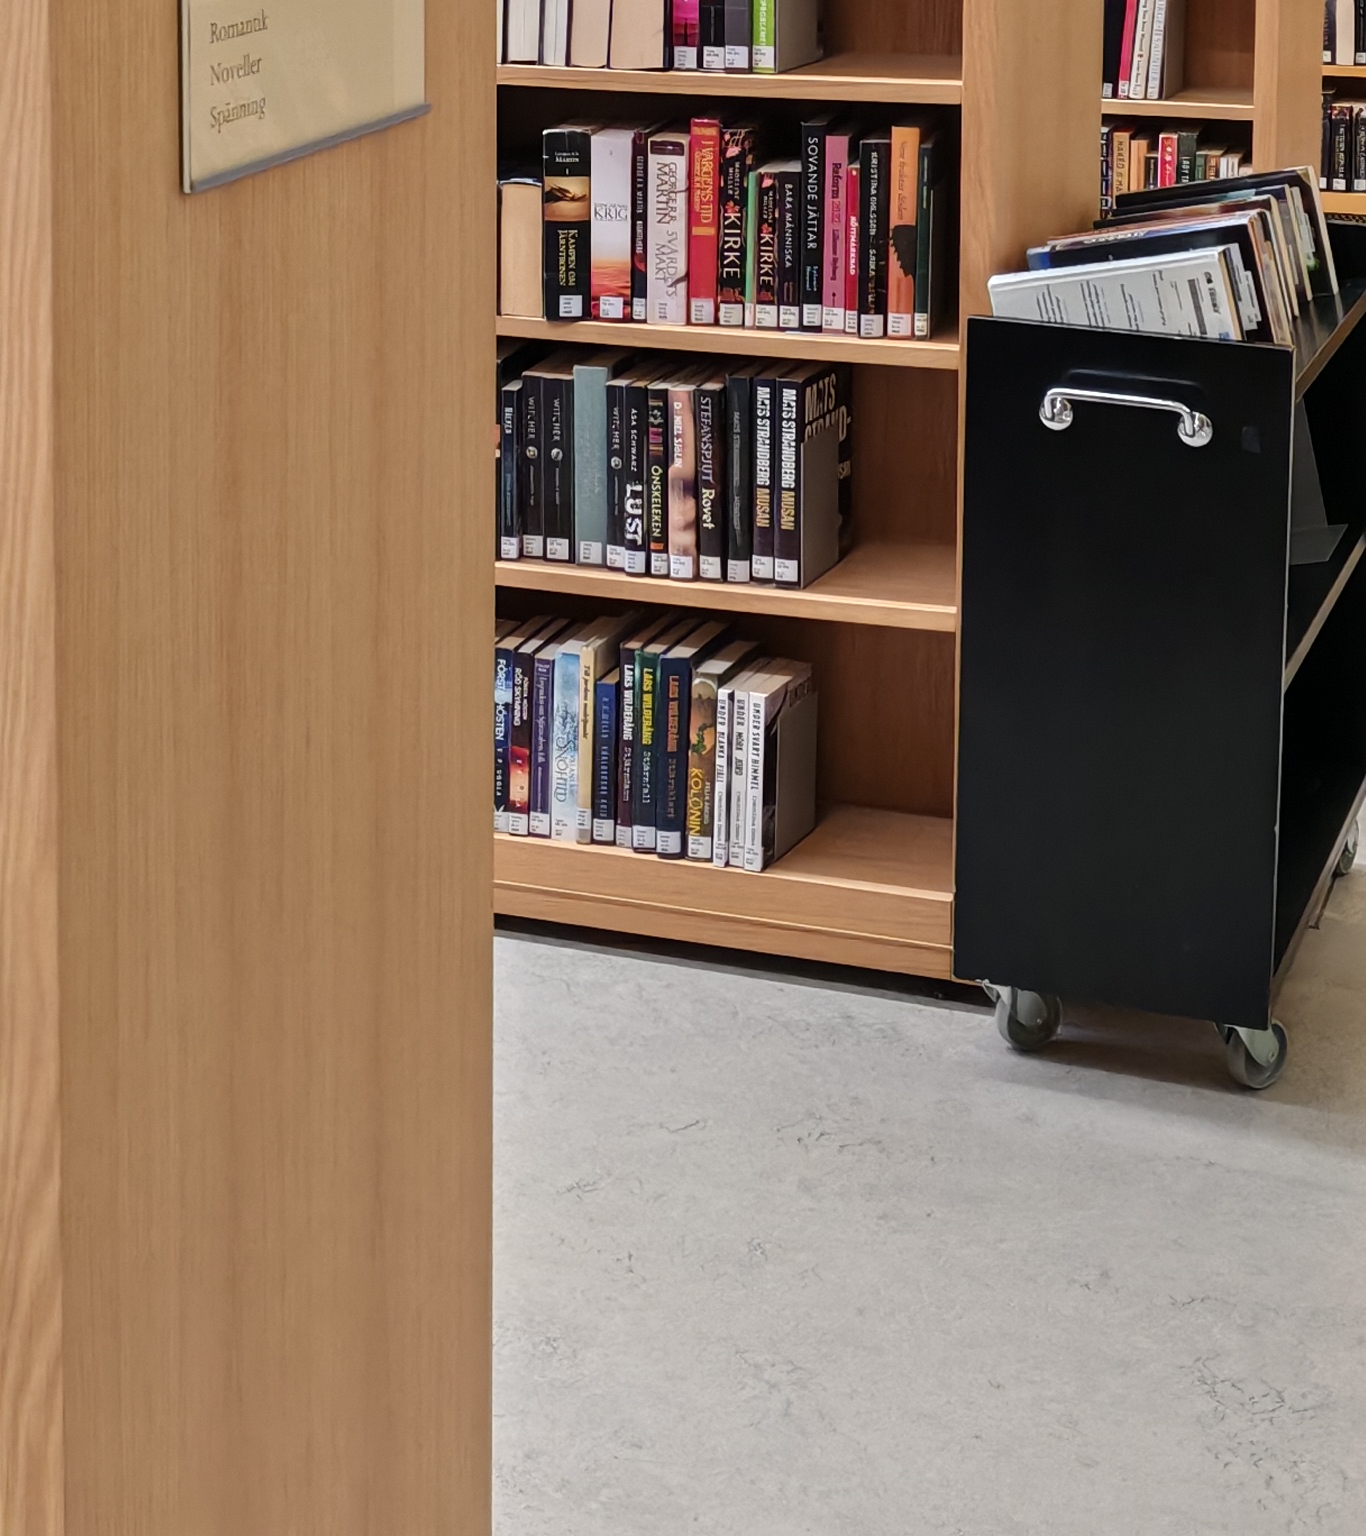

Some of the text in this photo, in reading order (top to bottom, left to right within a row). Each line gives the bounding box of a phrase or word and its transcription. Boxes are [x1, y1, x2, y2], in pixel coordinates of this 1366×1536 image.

[209, 10, 269, 44] Romantik
[210, 54, 262, 85] Noveller
[210, 97, 266, 133] Spänning
[807, 137, 817, 250] SOVANDE JÄTTAR
[724, 213, 741, 279] KIRKE
[623, 482, 643, 547] LUST
[650, 466, 662, 538] ÖNSKELEKEN
[701, 488, 715, 530] Rovet
[781, 490, 795, 530] MUSAN
[690, 767, 704, 835] KOLONIN
